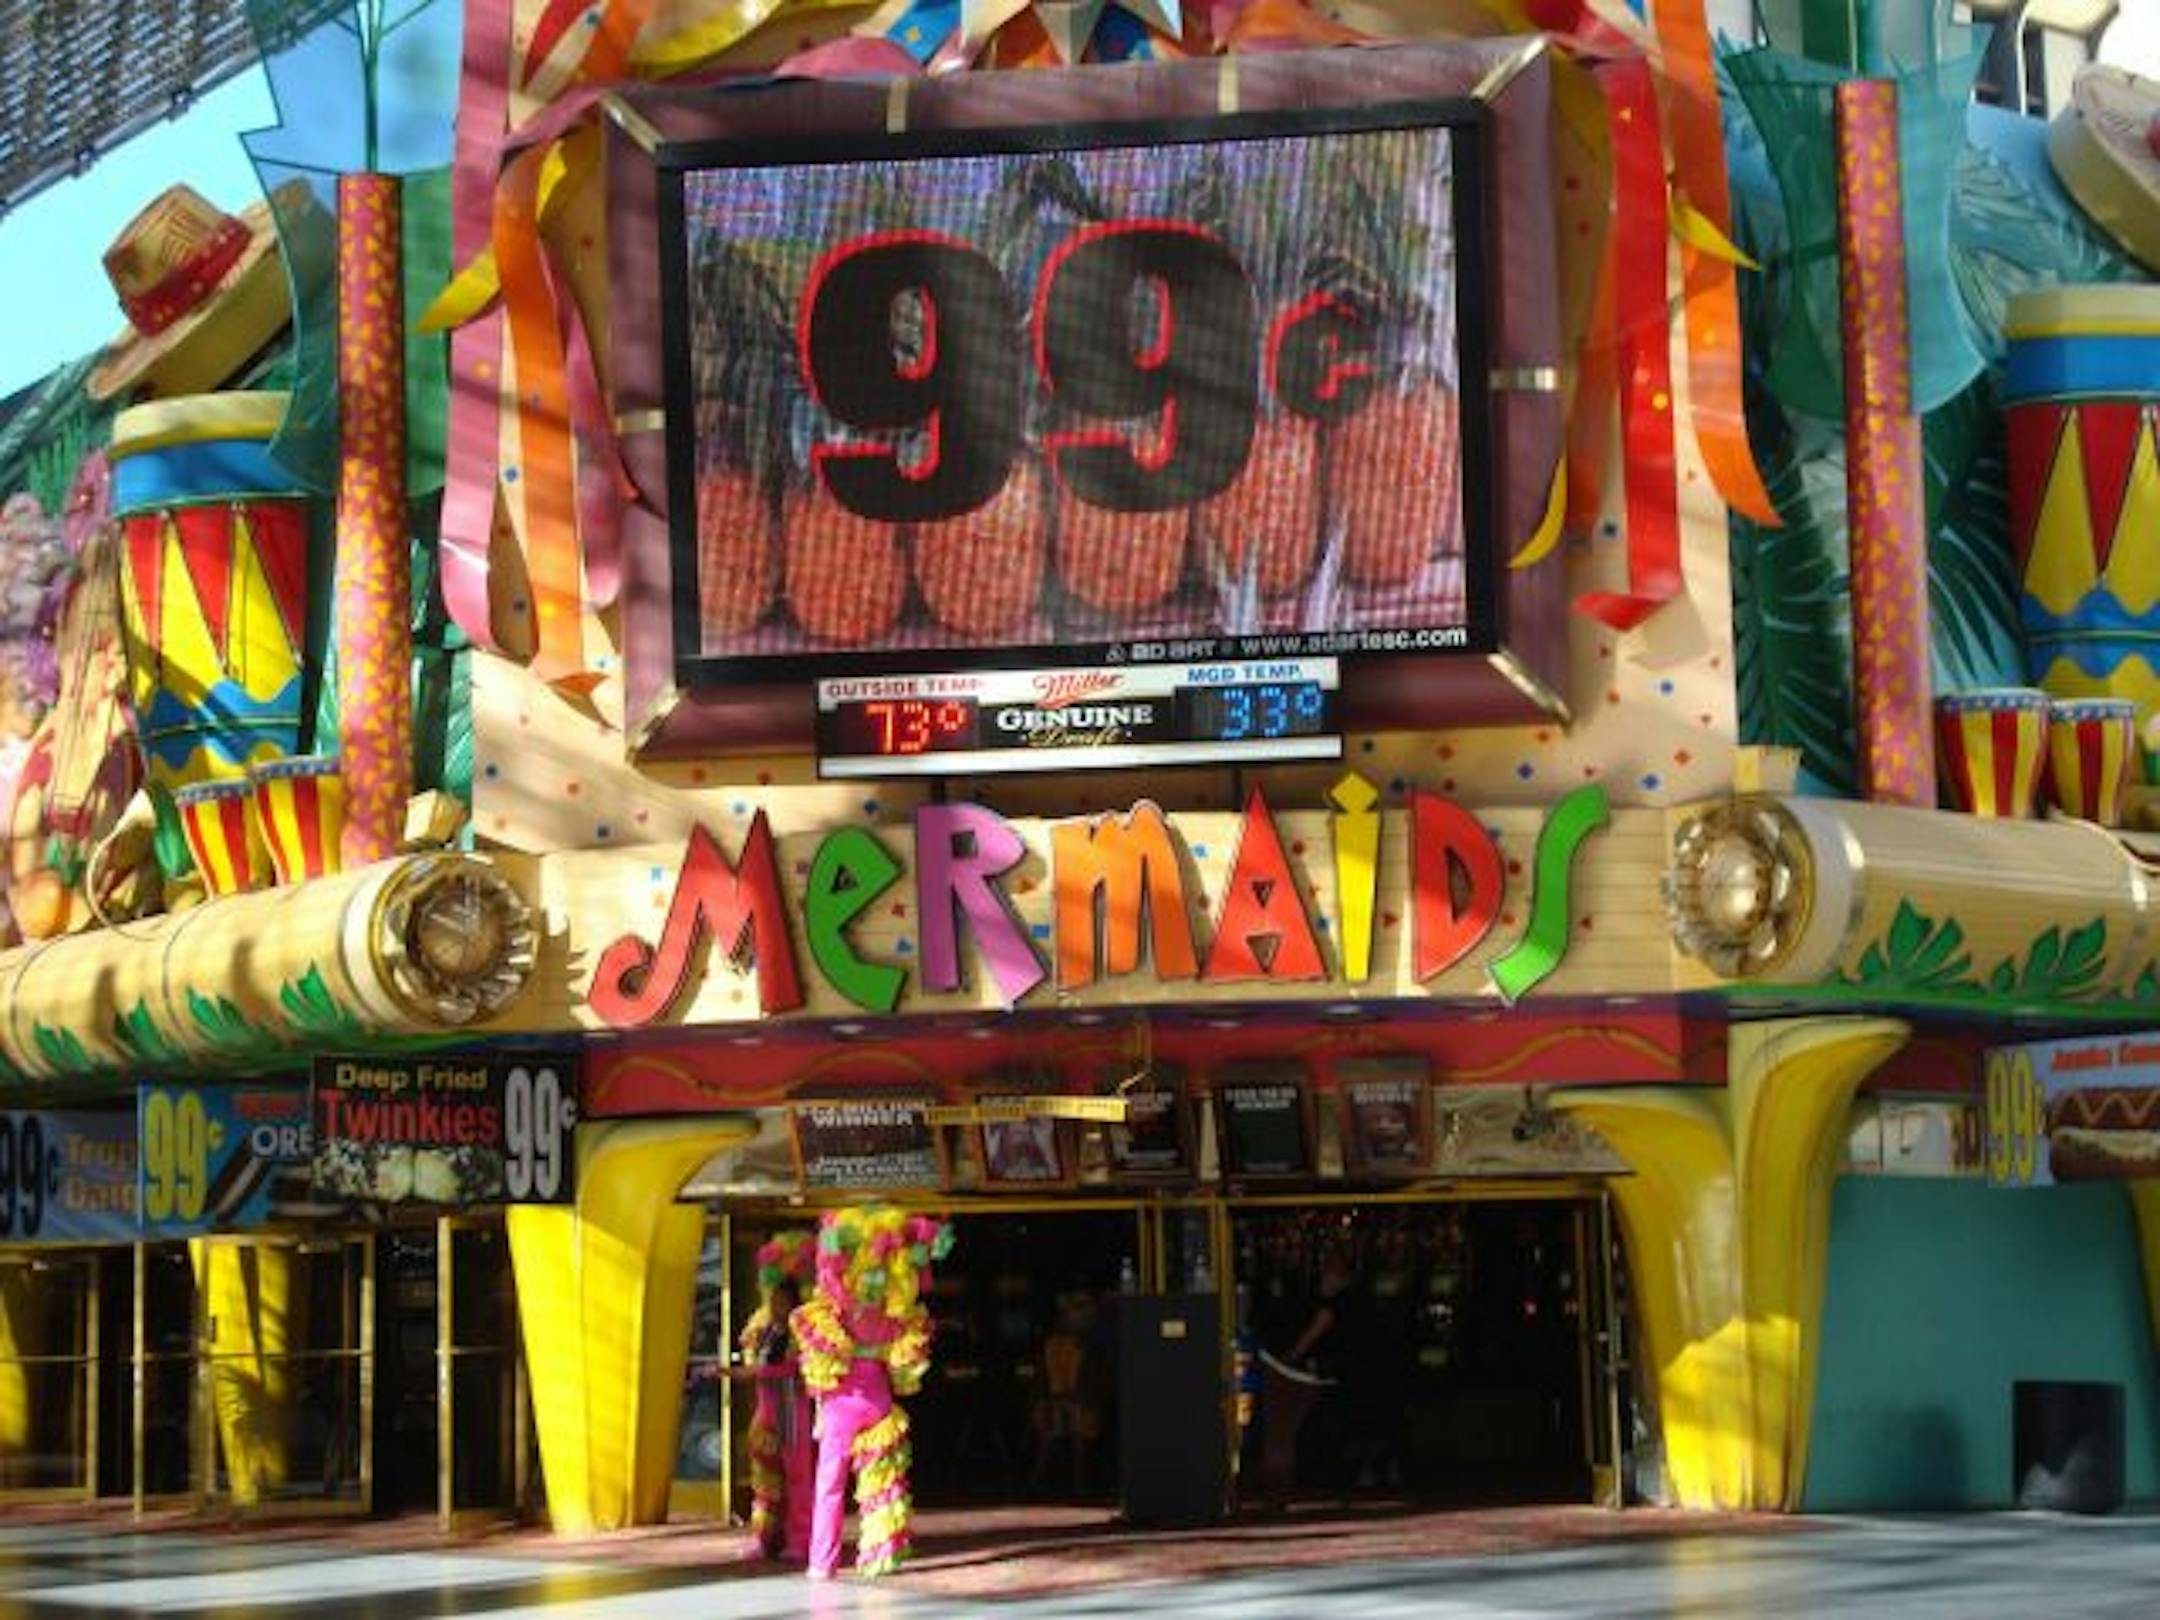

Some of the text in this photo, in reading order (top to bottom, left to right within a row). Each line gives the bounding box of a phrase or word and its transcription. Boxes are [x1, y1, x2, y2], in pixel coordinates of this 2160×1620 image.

[1188, 667, 1236, 682] MGD
[828, 681, 917, 697] OUTSIDE
[1032, 672, 1123, 709] Miller
[996, 705, 1153, 731] GENUINE
[336, 1064, 488, 1092] Deep Fried
[320, 1088, 499, 1144] Twinkies
